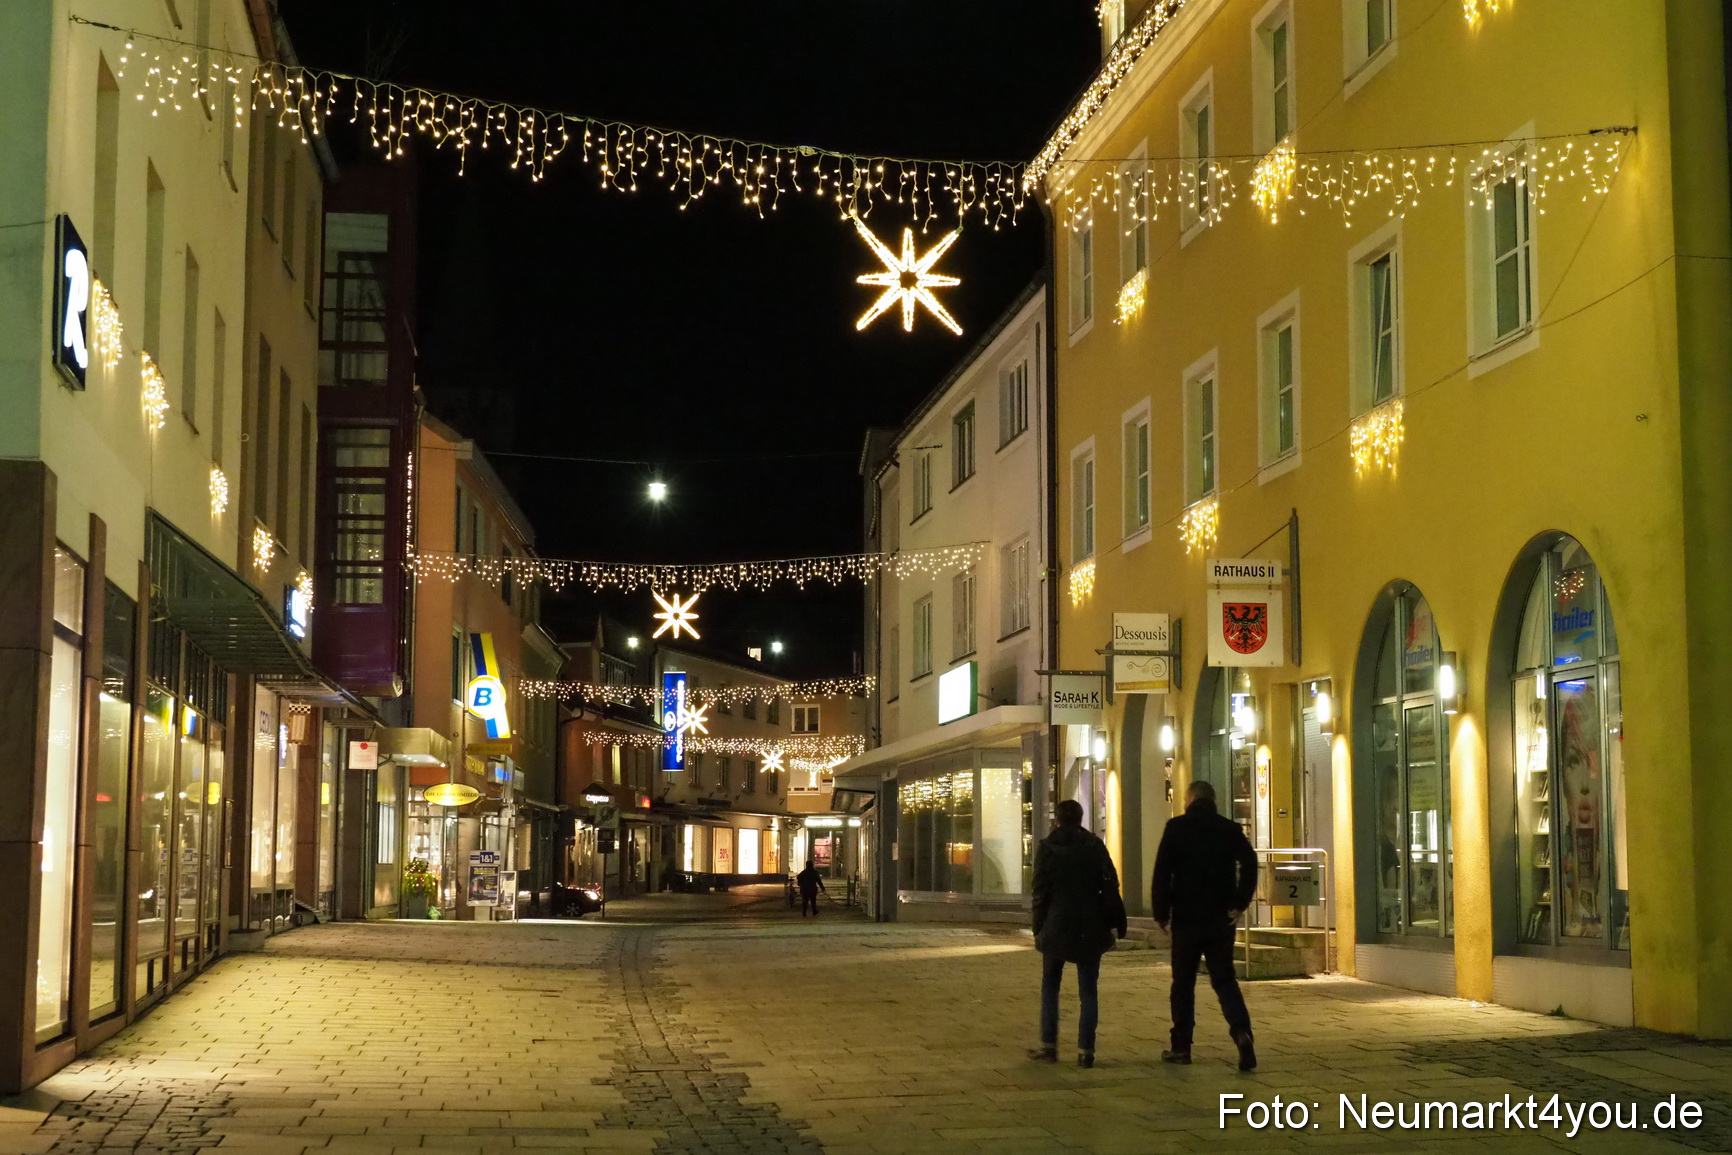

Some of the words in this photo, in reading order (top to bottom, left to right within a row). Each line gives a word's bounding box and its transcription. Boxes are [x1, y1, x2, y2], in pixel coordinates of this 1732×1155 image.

[63, 248, 89, 369] R
[1214, 565, 1266, 578] RATHAUS
[1268, 566, 1275, 578] II
[473, 687, 493, 707] B
[1054, 691, 1089, 704] SARAH
[1091, 691, 1099, 704] K
[480, 854, 494, 863] 1&1
[1289, 885, 1298, 898] 2
